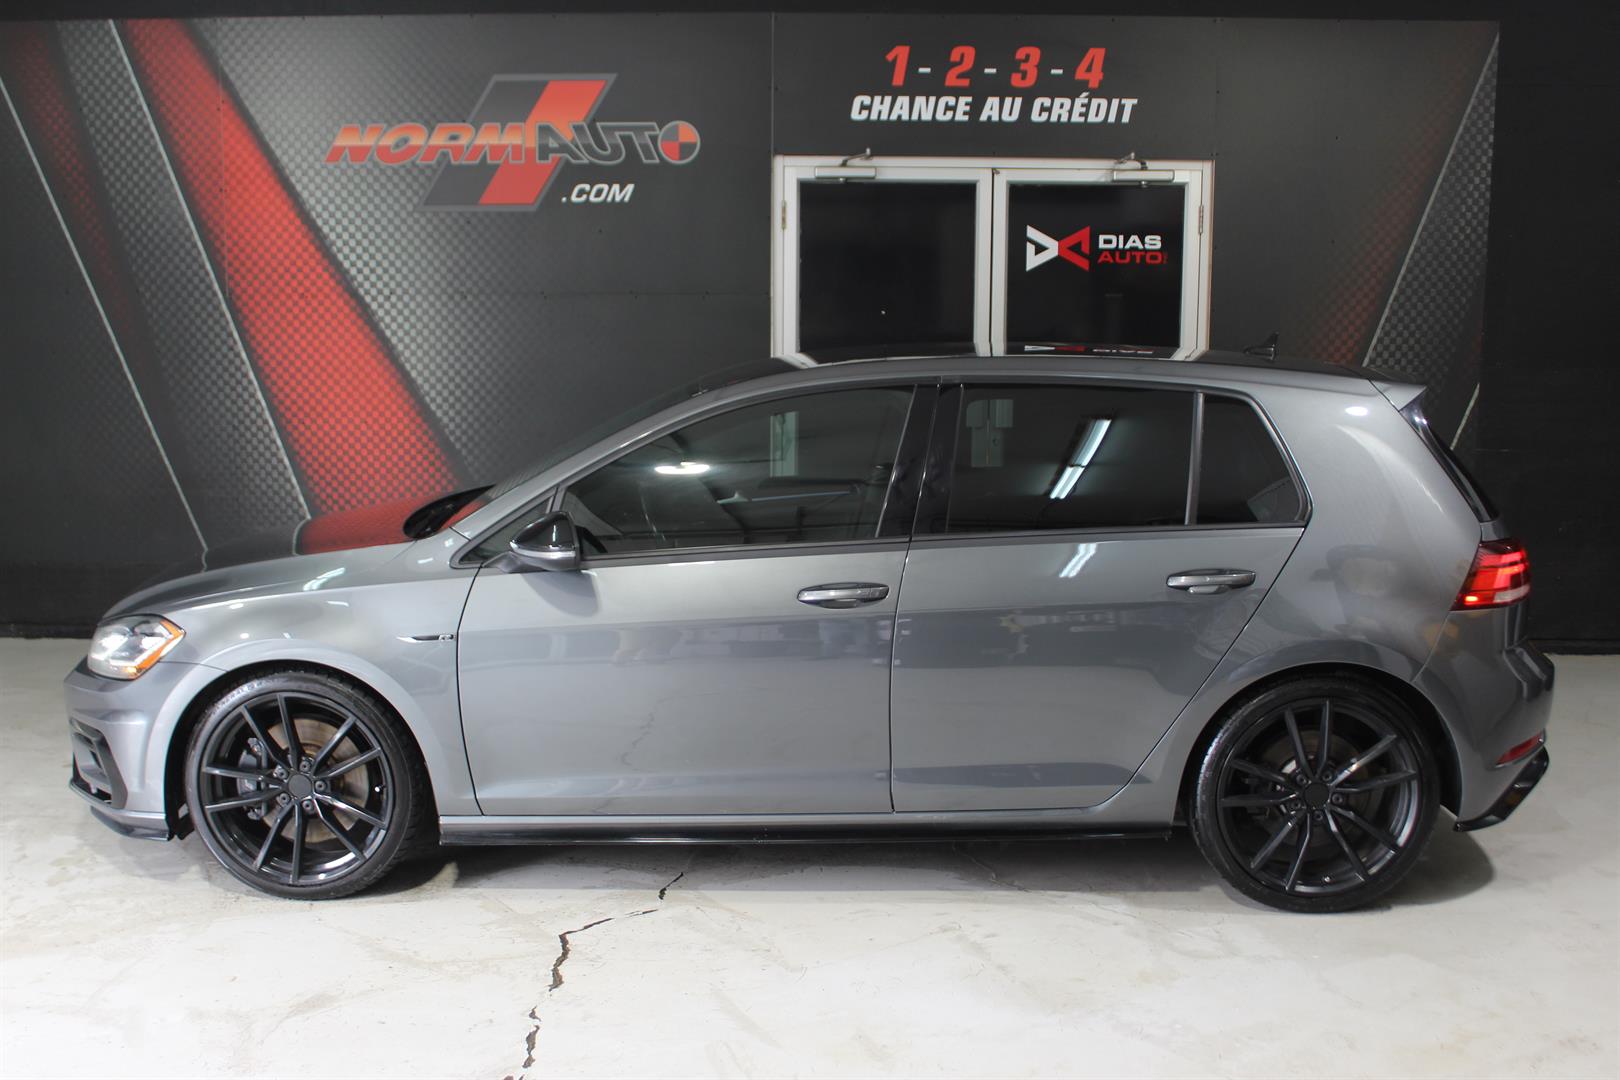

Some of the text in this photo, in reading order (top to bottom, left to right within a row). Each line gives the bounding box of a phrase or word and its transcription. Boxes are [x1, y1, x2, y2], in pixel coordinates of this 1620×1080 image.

[850, 91, 1139, 124] CHANCE AU CRÉDIT
[561, 183, 635, 203] .COM
[1098, 234, 1162, 250] DIAS
[1097, 251, 1163, 265] AUTO
